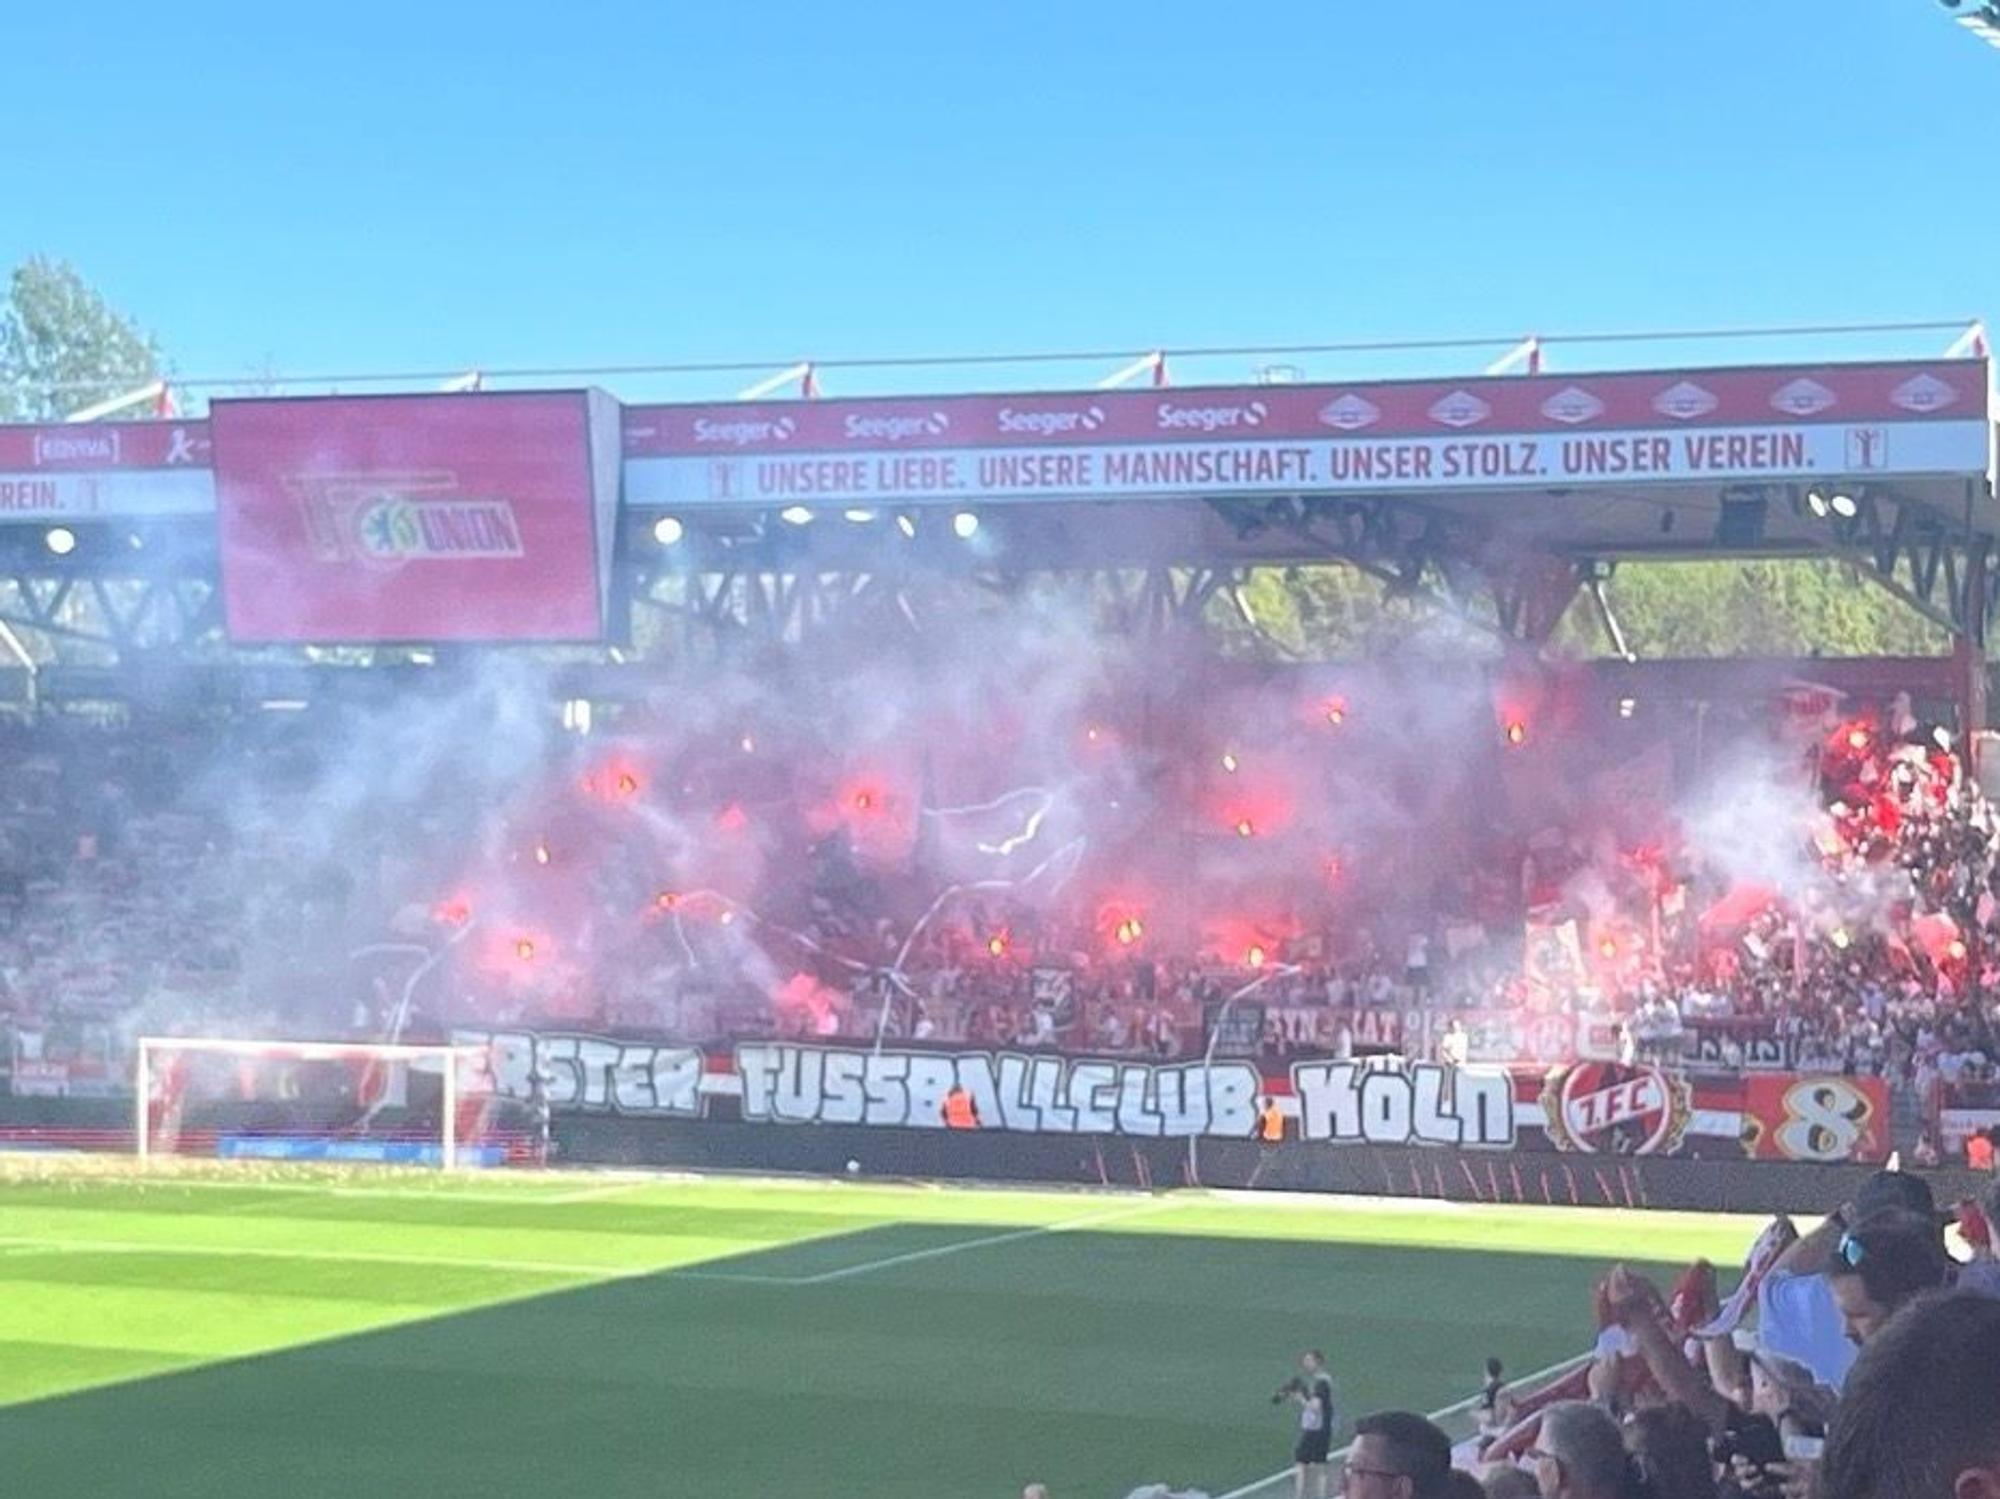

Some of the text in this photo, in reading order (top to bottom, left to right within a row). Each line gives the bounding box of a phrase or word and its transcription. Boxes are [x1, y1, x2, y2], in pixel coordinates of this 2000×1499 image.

[844, 414, 926, 440] Seeger
[998, 407, 1079, 434] Seeger
[1157, 403, 1242, 431] Seeger
[694, 419, 773, 444] Seeger
[757, 432, 1815, 494] UNSERE LIEBE. UNSERE MANNSCHAFT. UNSER STOLZ. UNSER VEREIN.
[452, 1030, 1517, 1147] ERSTER FUSSBALLCLUB KÖLN
